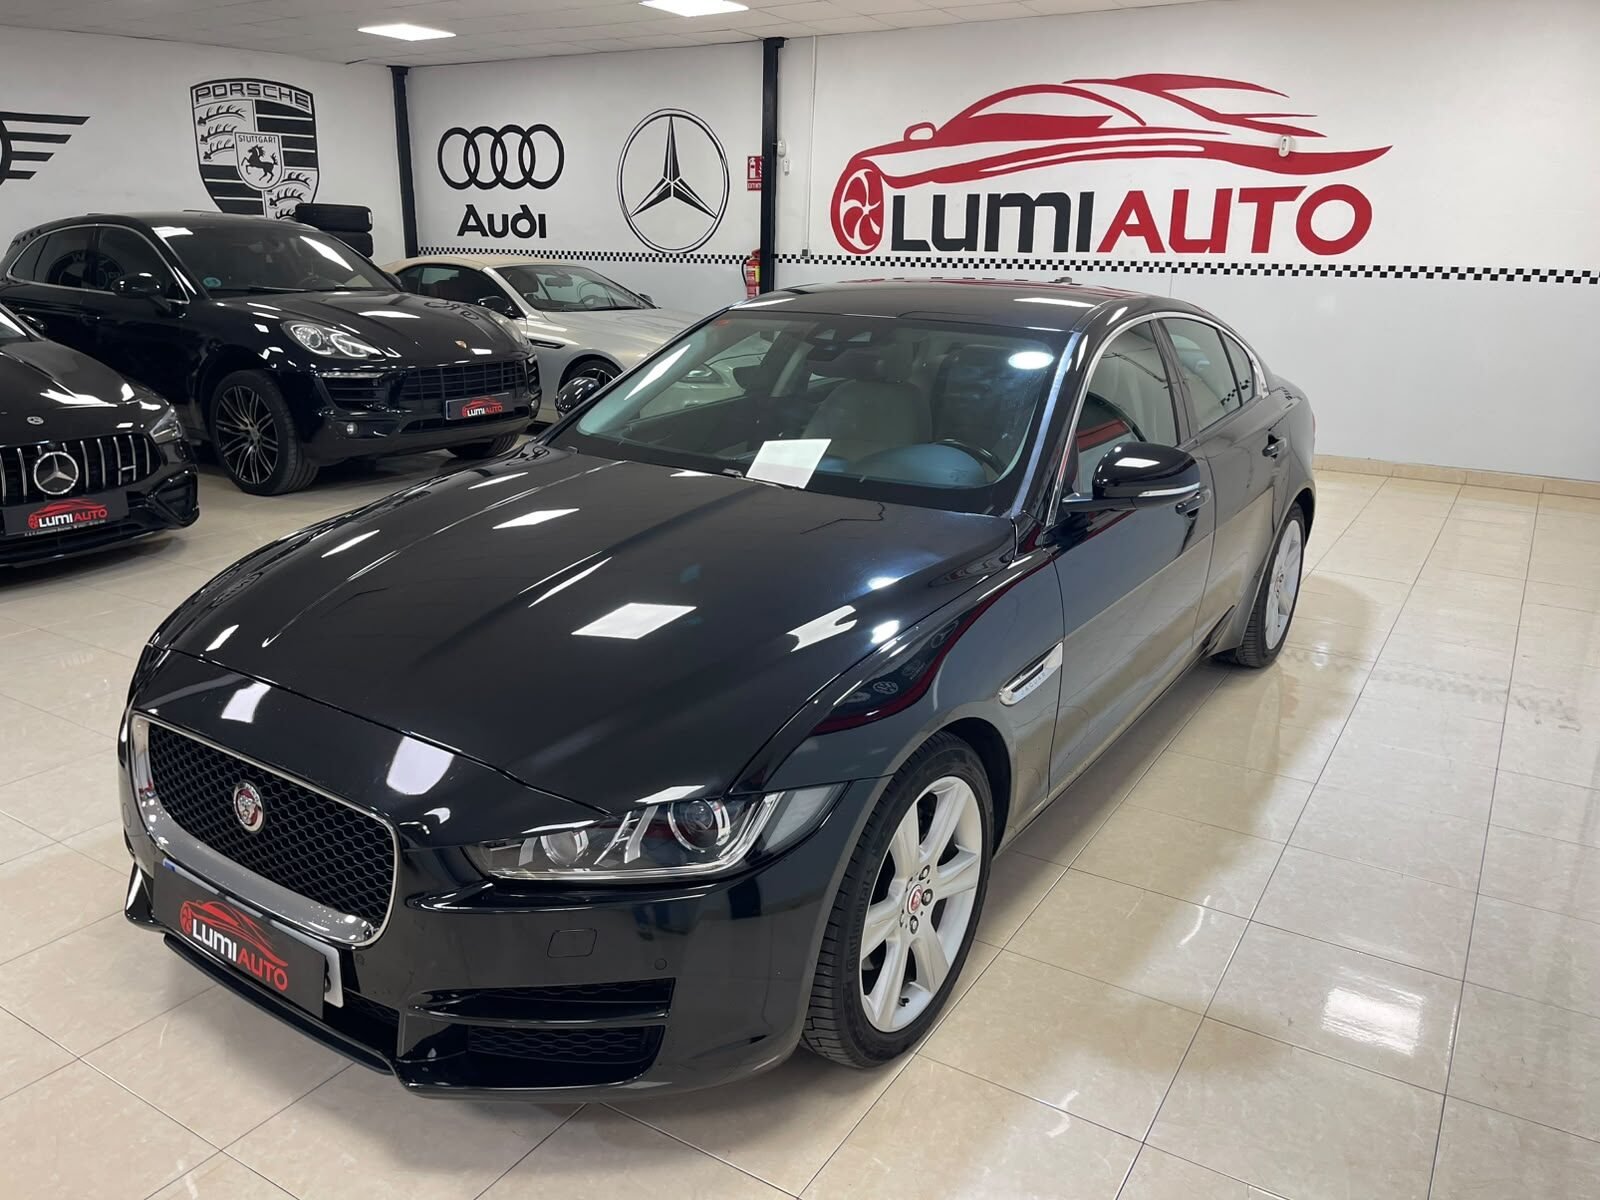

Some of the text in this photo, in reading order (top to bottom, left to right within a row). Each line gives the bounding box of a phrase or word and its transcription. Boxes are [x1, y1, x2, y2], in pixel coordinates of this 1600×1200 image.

[195, 83, 311, 111] PORSCHE
[238, 135, 277, 144] STUTTGART
[457, 204, 546, 238] Audi
